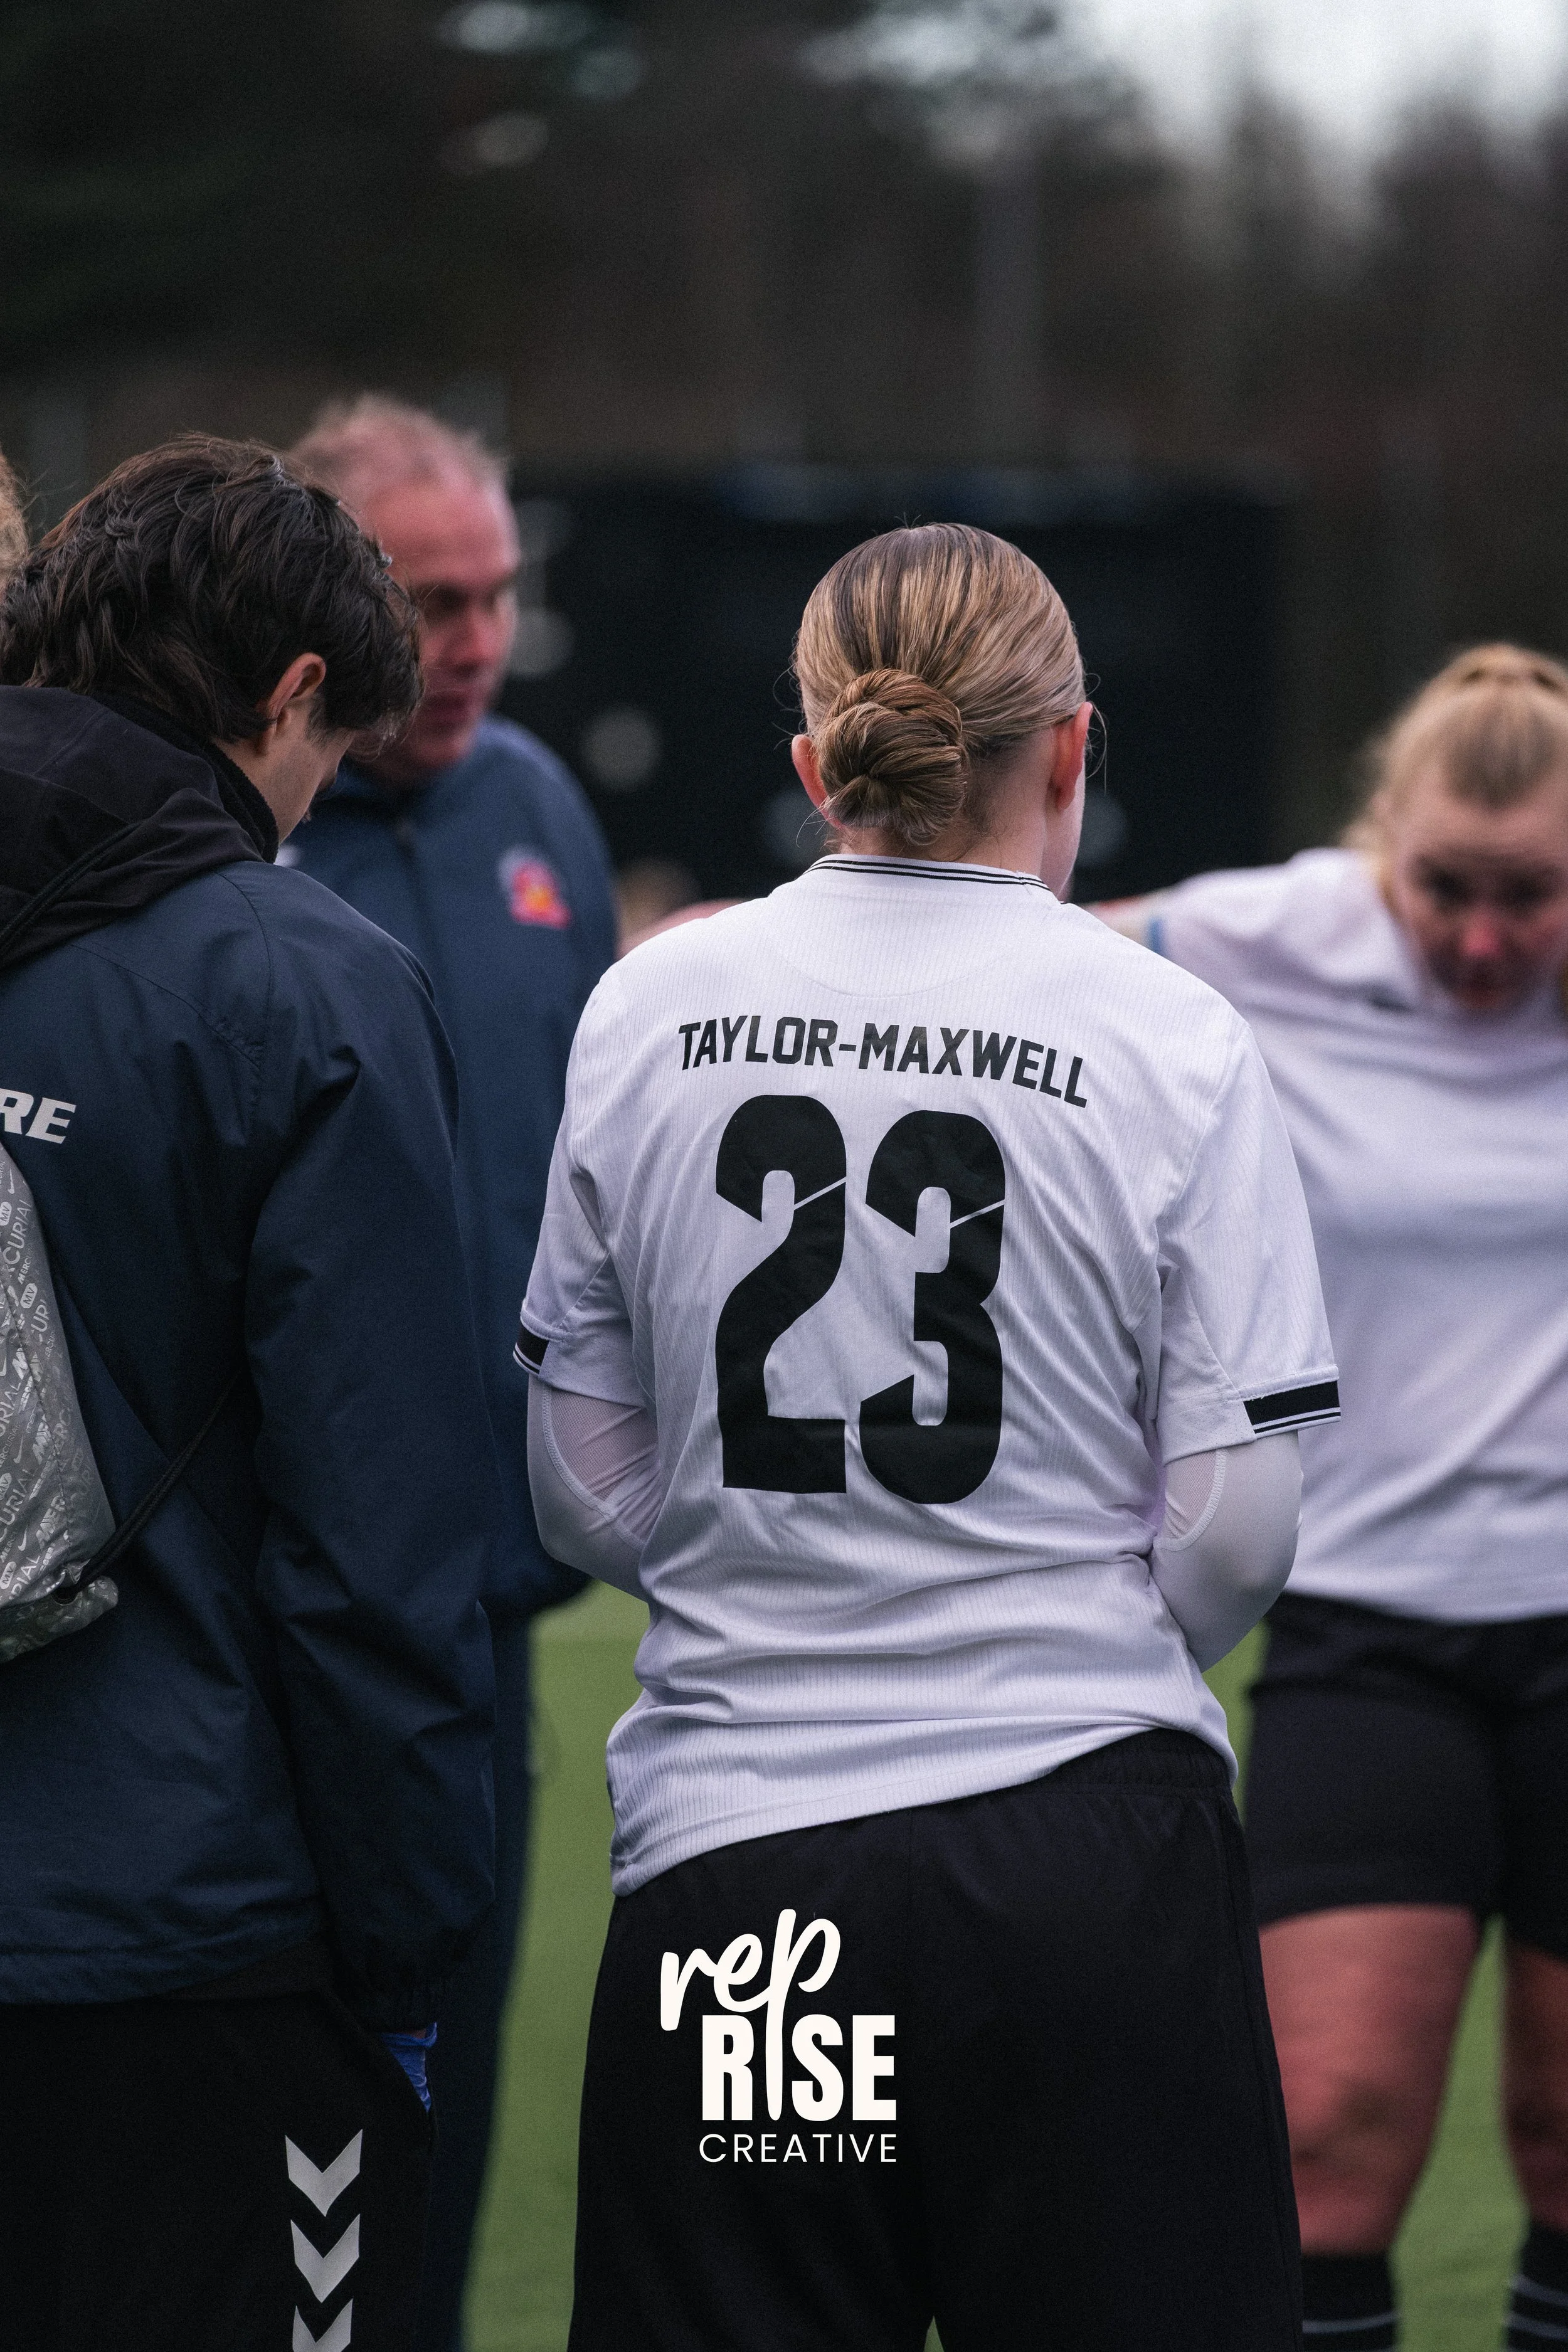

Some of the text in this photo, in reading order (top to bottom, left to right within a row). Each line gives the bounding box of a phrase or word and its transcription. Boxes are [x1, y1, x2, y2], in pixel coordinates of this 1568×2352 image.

[679, 1015, 1088, 1108] TAYLOR-MAXWELL
[23, 1286, 34, 1305] MV
[716, 1094, 1005, 1505] 23
[3, 1569, 14, 1584] MV
